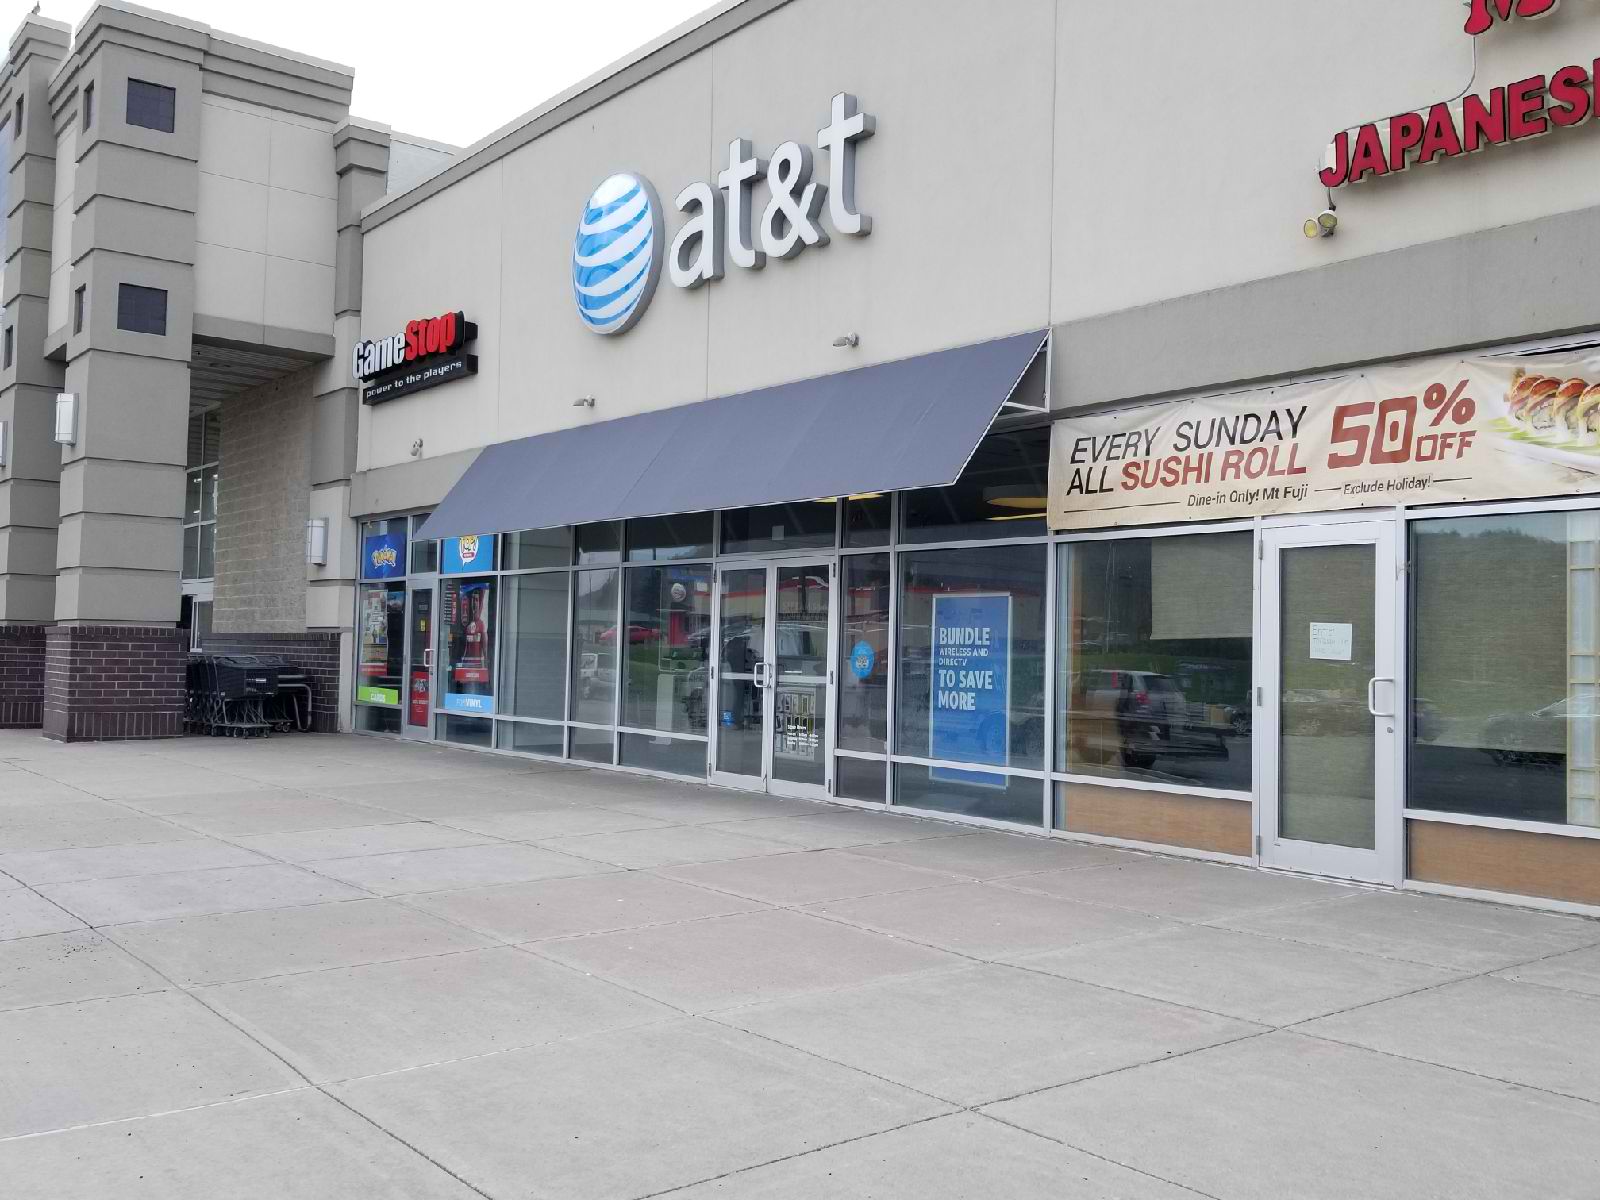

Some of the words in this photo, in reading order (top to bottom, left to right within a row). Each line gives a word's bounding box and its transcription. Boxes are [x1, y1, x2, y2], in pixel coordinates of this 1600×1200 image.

[1318, 57, 1600, 188] JAPANES
[352, 311, 458, 380] GameStop
[366, 383, 392, 399] power
[394, 379, 404, 388] to
[406, 373, 422, 385] the
[424, 361, 462, 381] players
[1070, 426, 1161, 464] EVERY
[1172, 405, 1308, 452] SUNDAY
[1415, 430, 1478, 463] OFF
[1066, 465, 1115, 496] ALL
[1120, 451, 1214, 491] SUSHI
[1219, 442, 1307, 482] ROLL
[1187, 491, 1226, 508] Dine-in
[1229, 488, 1260, 506] Only!
[1262, 488, 1280, 501] Mt
[1283, 484, 1309, 502] Fuji
[1343, 481, 1384, 496] Exclude
[1386, 475, 1432, 492] Holiday!
[939, 627, 991, 646] BUNDLE
[972, 648, 989, 657] AND
[938, 669, 956, 688] TO
[959, 670, 993, 689] SAVE
[938, 690, 976, 711] MORE
